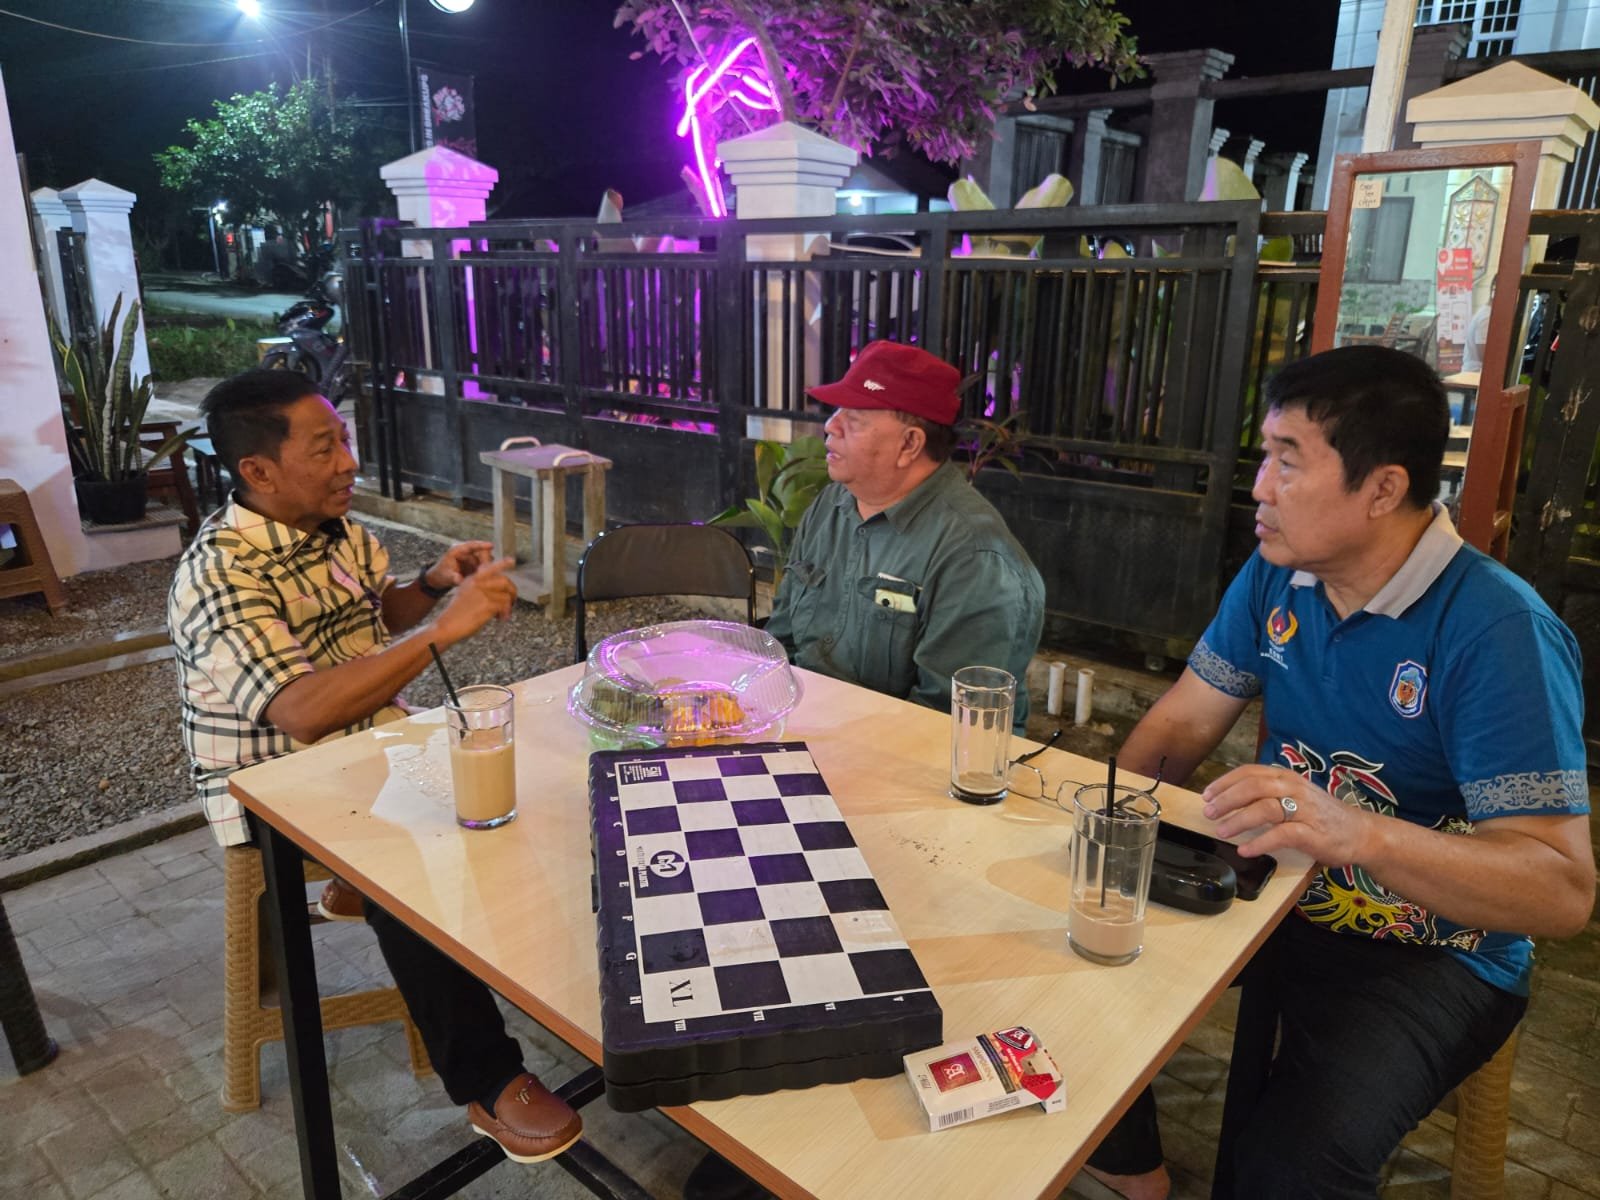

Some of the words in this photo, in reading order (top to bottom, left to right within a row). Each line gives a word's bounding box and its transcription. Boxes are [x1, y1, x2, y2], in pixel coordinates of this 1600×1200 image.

[626, 952, 638, 961] G
[669, 979, 694, 1007] XL
[629, 995, 642, 1005] H
